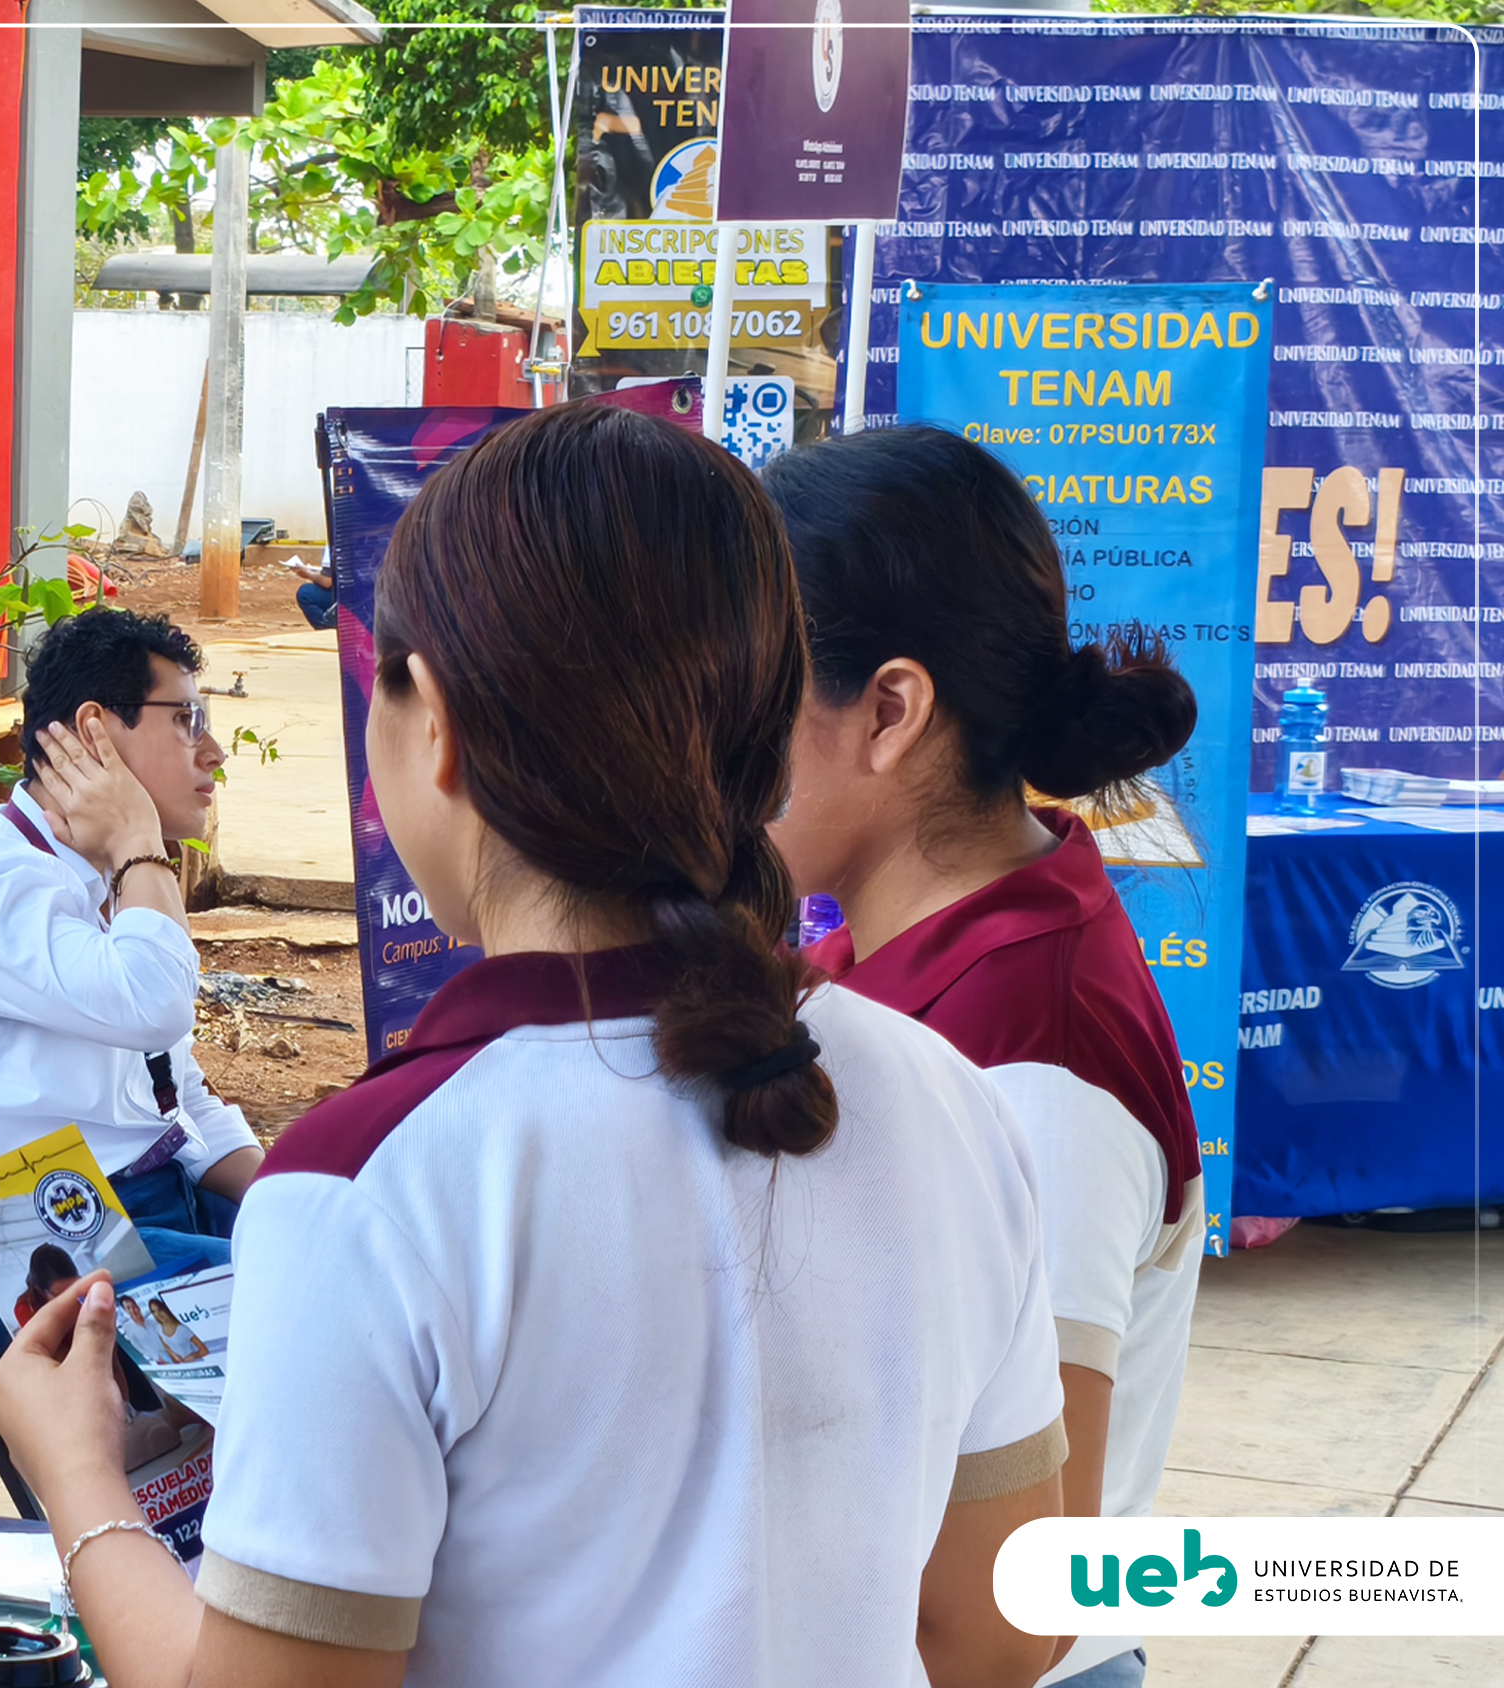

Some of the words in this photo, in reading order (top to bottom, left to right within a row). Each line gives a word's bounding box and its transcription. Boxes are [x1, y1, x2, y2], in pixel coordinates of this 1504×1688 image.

[953, 84, 995, 102] TENAM
[1005, 84, 1092, 103] UNIVERSIDAD
[1094, 84, 1141, 102] TENAM
[1150, 83, 1233, 102] UNIVERSIDAD
[1235, 84, 1278, 102] TENAM
[1288, 87, 1373, 107] UNIVERSIDAD
[1373, 91, 1419, 109] TENAM
[947, 153, 994, 171] TENAM
[1004, 152, 1090, 170] UNIVERSIDAD
[1091, 153, 1139, 169] TENAM
[1147, 152, 1228, 170] UNIVERSIDAD
[1229, 153, 1276, 170] TENAM
[1287, 154, 1370, 175] UNIVERSIDAD
[1371, 157, 1416, 176] TENAM
[599, 229, 804, 254] INSCRIPCONES
[947, 221, 993, 238] TENAM
[1002, 220, 1089, 236] UNIVERSIDAD
[1090, 220, 1134, 236] TENAM
[1140, 219, 1225, 236] UNIVERSIDAD
[1226, 220, 1274, 237] TENAM
[1283, 220, 1362, 240] UNIVERSIDAD
[1362, 224, 1411, 242] TENAM
[1279, 287, 1360, 304] UNIVERSIDAD
[1410, 291, 1500, 310] UNIVERSIDAD
[608, 310, 659, 339] 961
[730, 310, 802, 338] 7062
[920, 311, 1260, 349] UNIVERSIDAD
[1274, 345, 1357, 362] UNIVERSIDAD
[1360, 346, 1402, 363] TENAM
[1409, 348, 1494, 365] UNIVERSIDAD
[999, 369, 1172, 407] TENAM
[1269, 411, 1353, 428] UNIVERSIDAD
[1354, 411, 1400, 429] TENAM
[1410, 413, 1488, 431] UNIVERSIDAD
[964, 422, 1041, 445] Clave:
[1049, 423, 1216, 445] 07PSU0173X
[1404, 477, 1485, 495] UNIVERSIDAD
[1093, 546, 1193, 567] PÚBLICA
[1401, 541, 1482, 560] UNIVERSIDAD
[1400, 606, 1480, 623] UNIVERSIDAD
[1255, 662, 1336, 679] UNIVERSIDAD
[1338, 662, 1384, 679] TENAM
[1394, 662, 1476, 679] UNIVERSIDAD
[1335, 725, 1379, 742] TENAM
[1389, 725, 1473, 743] UNIVERSIDAD
[382, 935, 444, 965] Campus:
